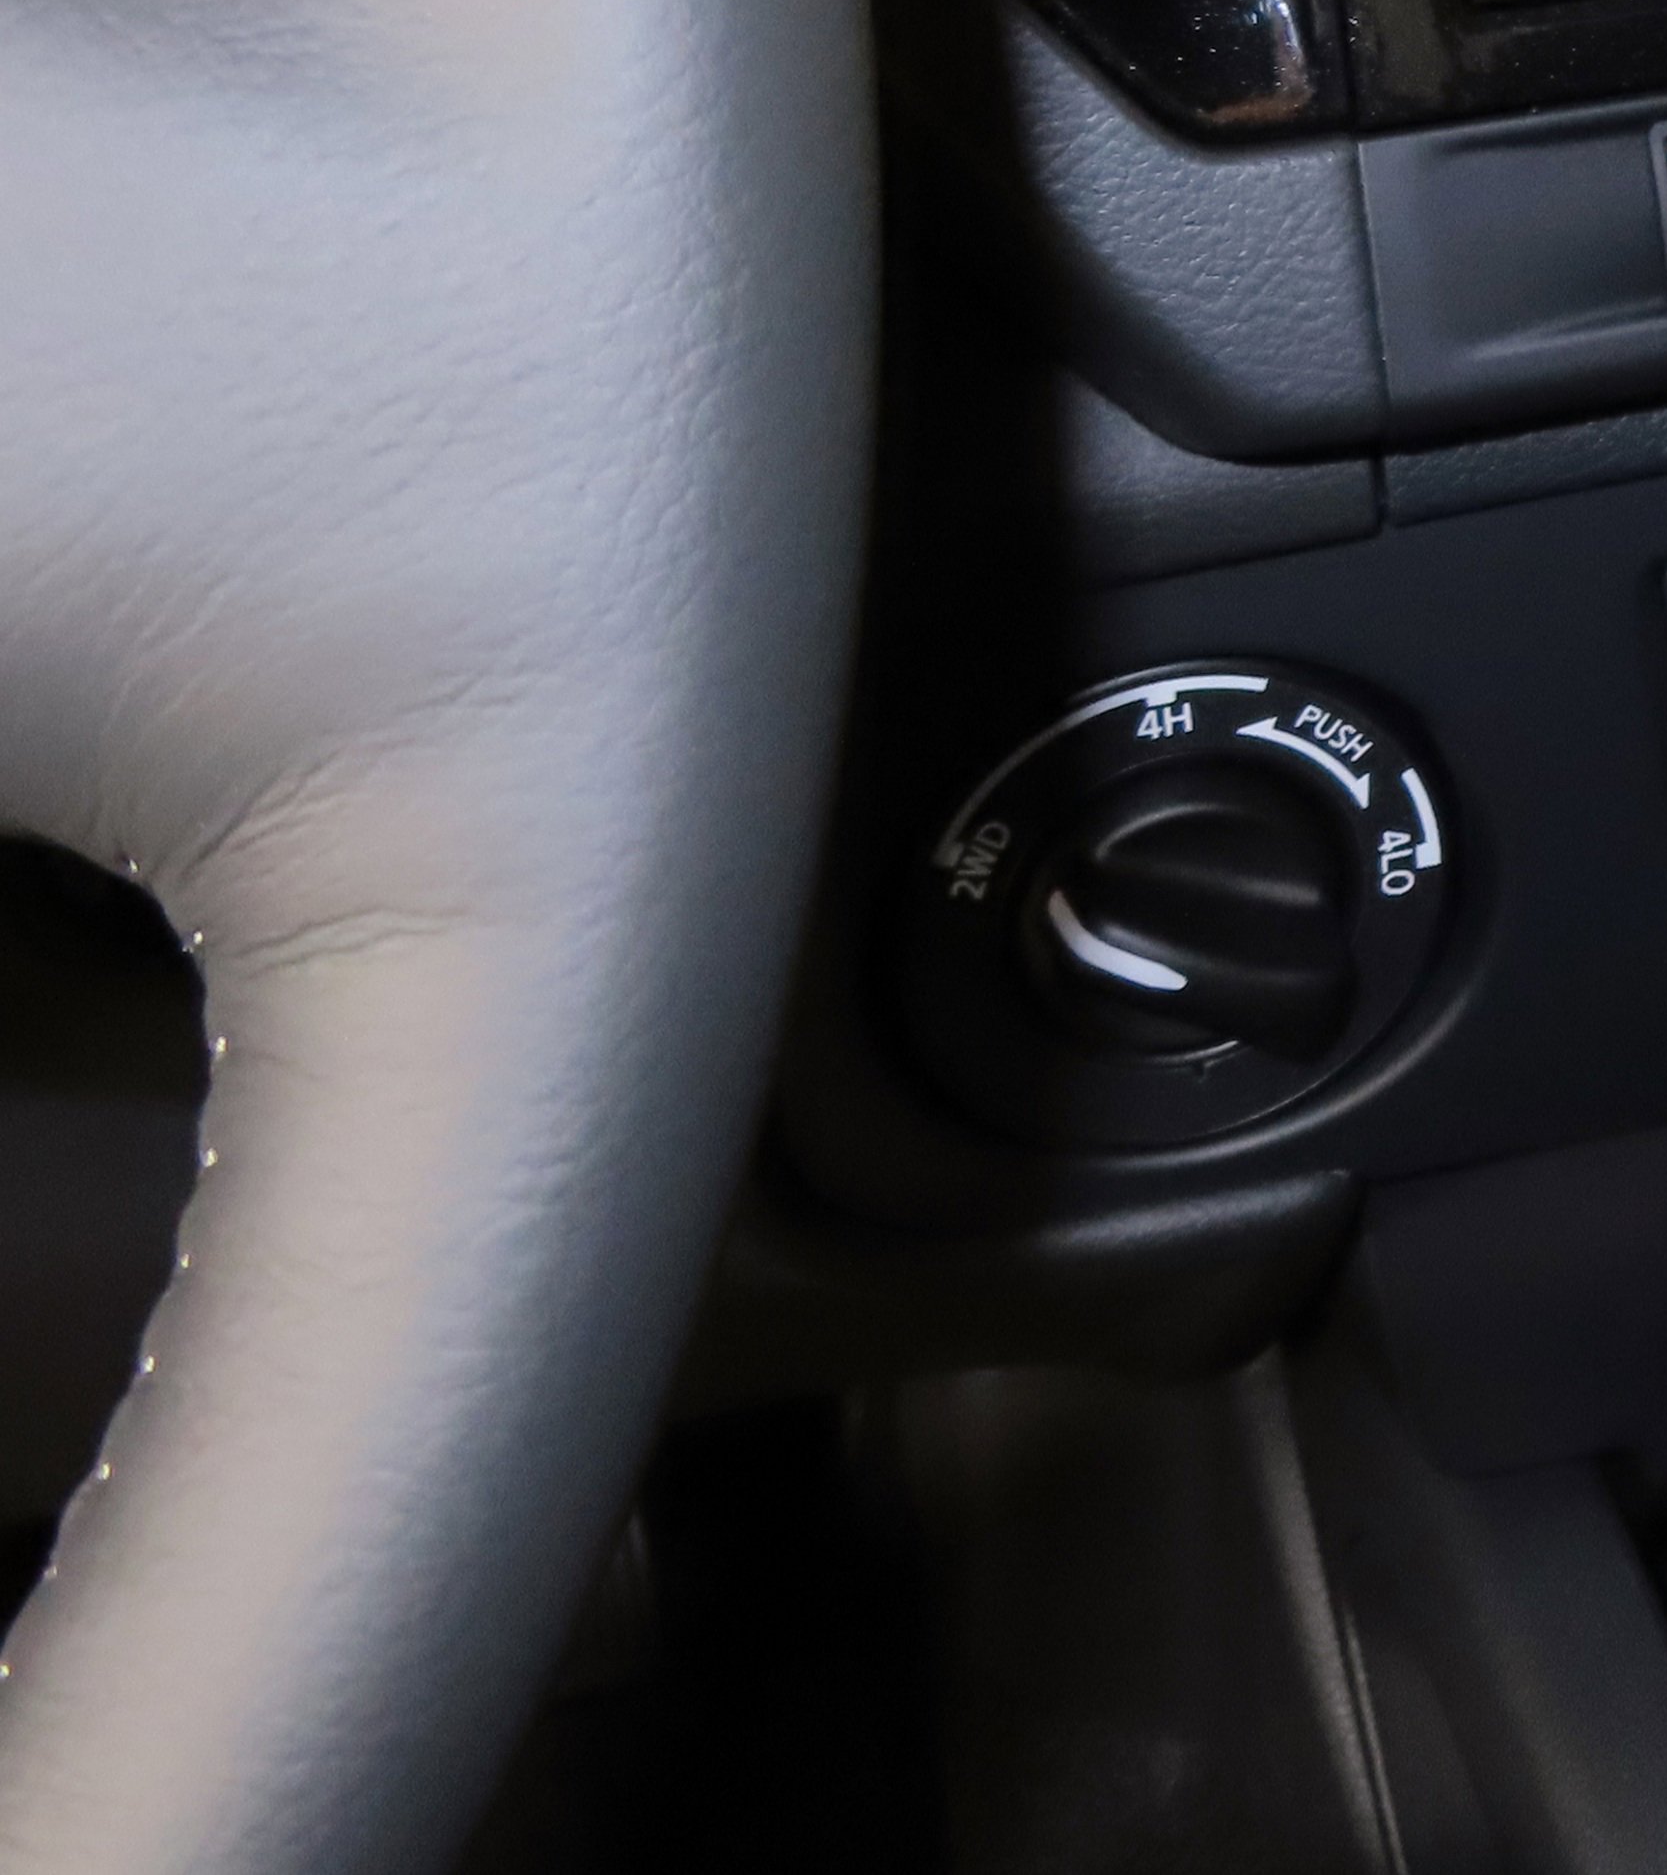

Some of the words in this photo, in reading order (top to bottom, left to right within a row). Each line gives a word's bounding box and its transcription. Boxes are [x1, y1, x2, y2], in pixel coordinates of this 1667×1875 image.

[1136, 702, 1195, 742] 4H
[1293, 703, 1374, 764] PUSH
[949, 821, 1010, 901] 2WD
[1376, 827, 1418, 899] 4LO
